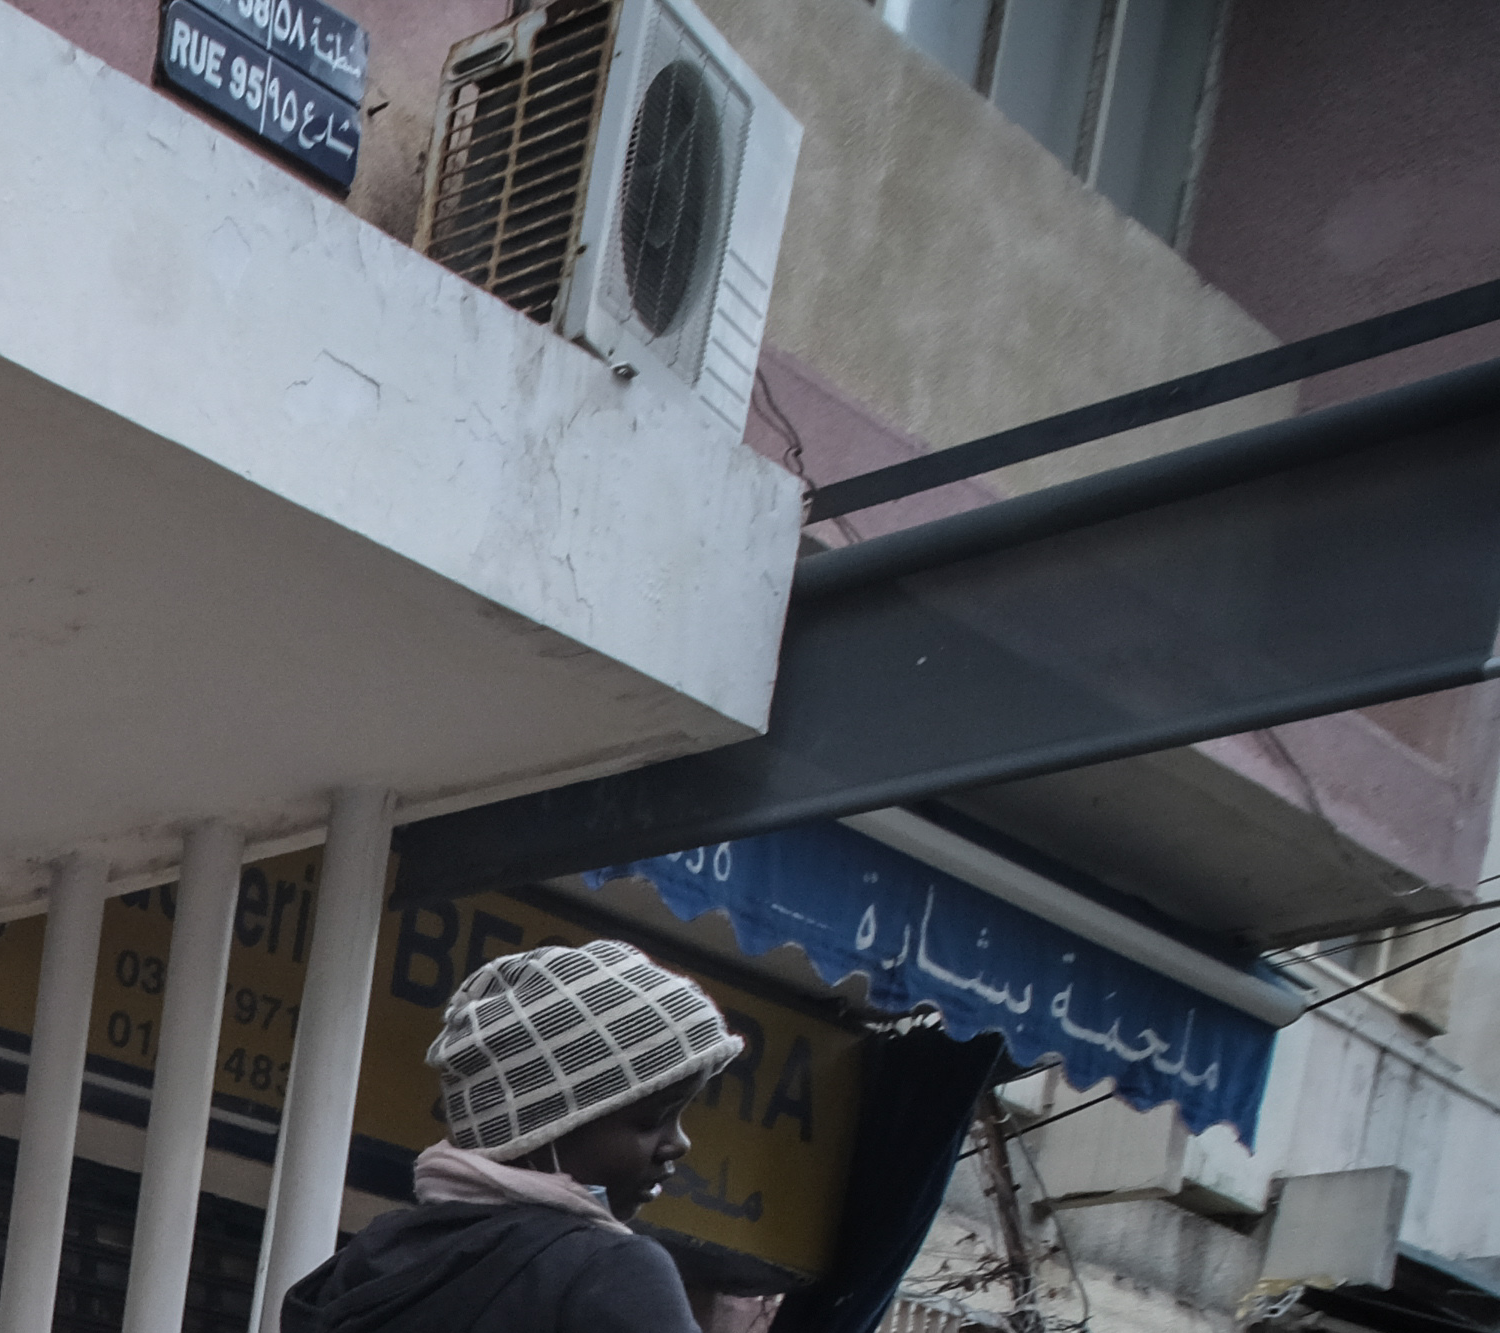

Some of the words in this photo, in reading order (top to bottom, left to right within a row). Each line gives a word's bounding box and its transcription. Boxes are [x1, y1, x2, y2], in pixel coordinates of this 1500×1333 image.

[169, 18, 227, 89] RUE
[228, 55, 265, 111] 95
[854, 870, 1034, 1034] بشارة
